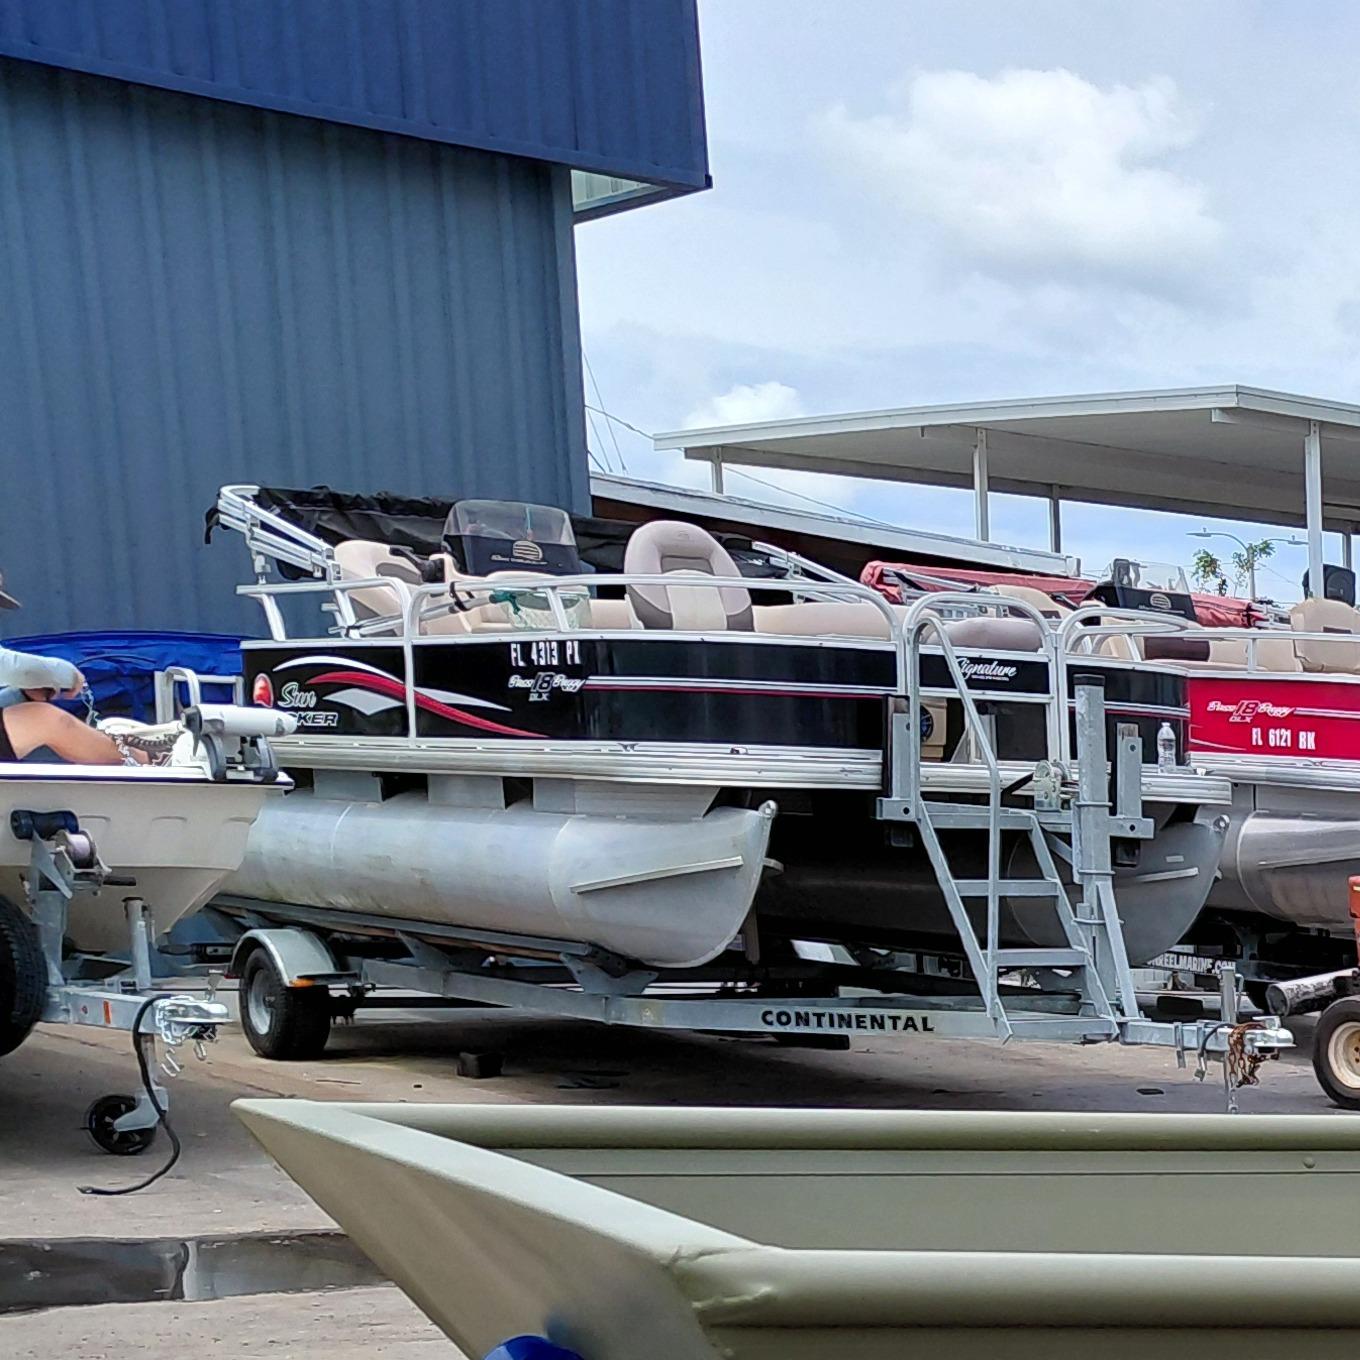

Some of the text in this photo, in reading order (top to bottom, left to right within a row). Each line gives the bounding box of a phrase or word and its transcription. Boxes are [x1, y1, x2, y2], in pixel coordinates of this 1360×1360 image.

[510, 643, 526, 667] FL
[530, 671, 556, 692] 18
[277, 681, 317, 708] Sun
[287, 711, 339, 726] KER
[1233, 699, 1261, 716] 18
[1251, 727, 1316, 750] FL 6121 BK
[761, 1010, 935, 1032] CONTINENTAL
